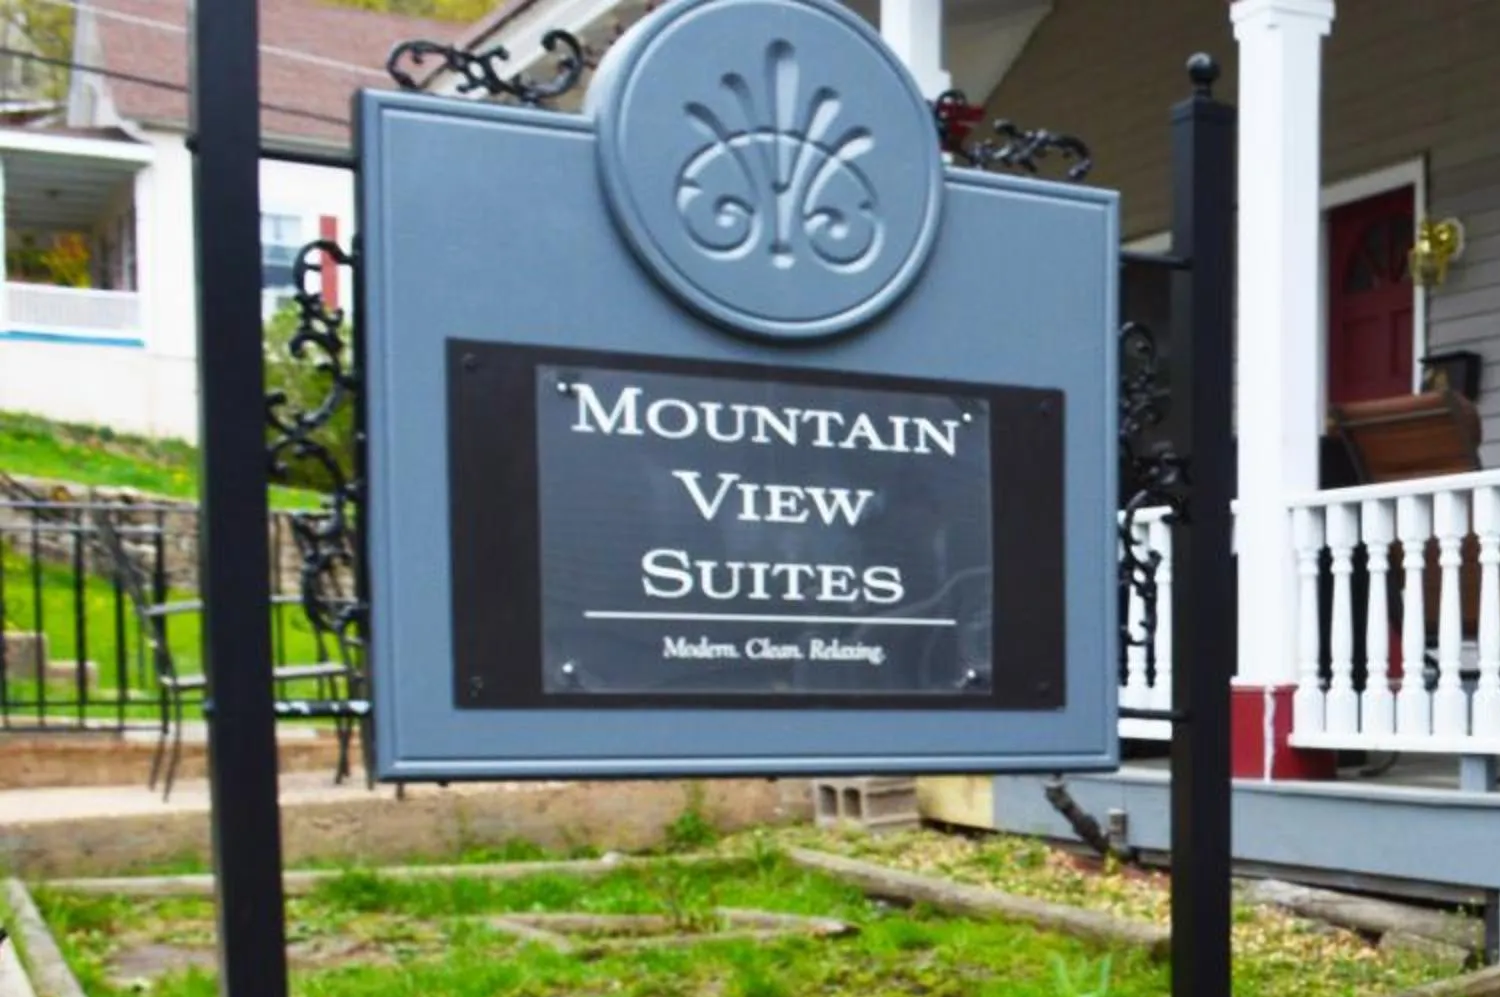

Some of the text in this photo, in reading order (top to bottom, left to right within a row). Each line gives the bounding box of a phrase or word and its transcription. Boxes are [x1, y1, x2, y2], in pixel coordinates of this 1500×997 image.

[571, 383, 960, 457] MOUNTAIN
[671, 470, 874, 526] VIEW
[641, 549, 905, 604] SUITES
[662, 636, 741, 659] Modern.
[745, 638, 804, 661] Clean.
